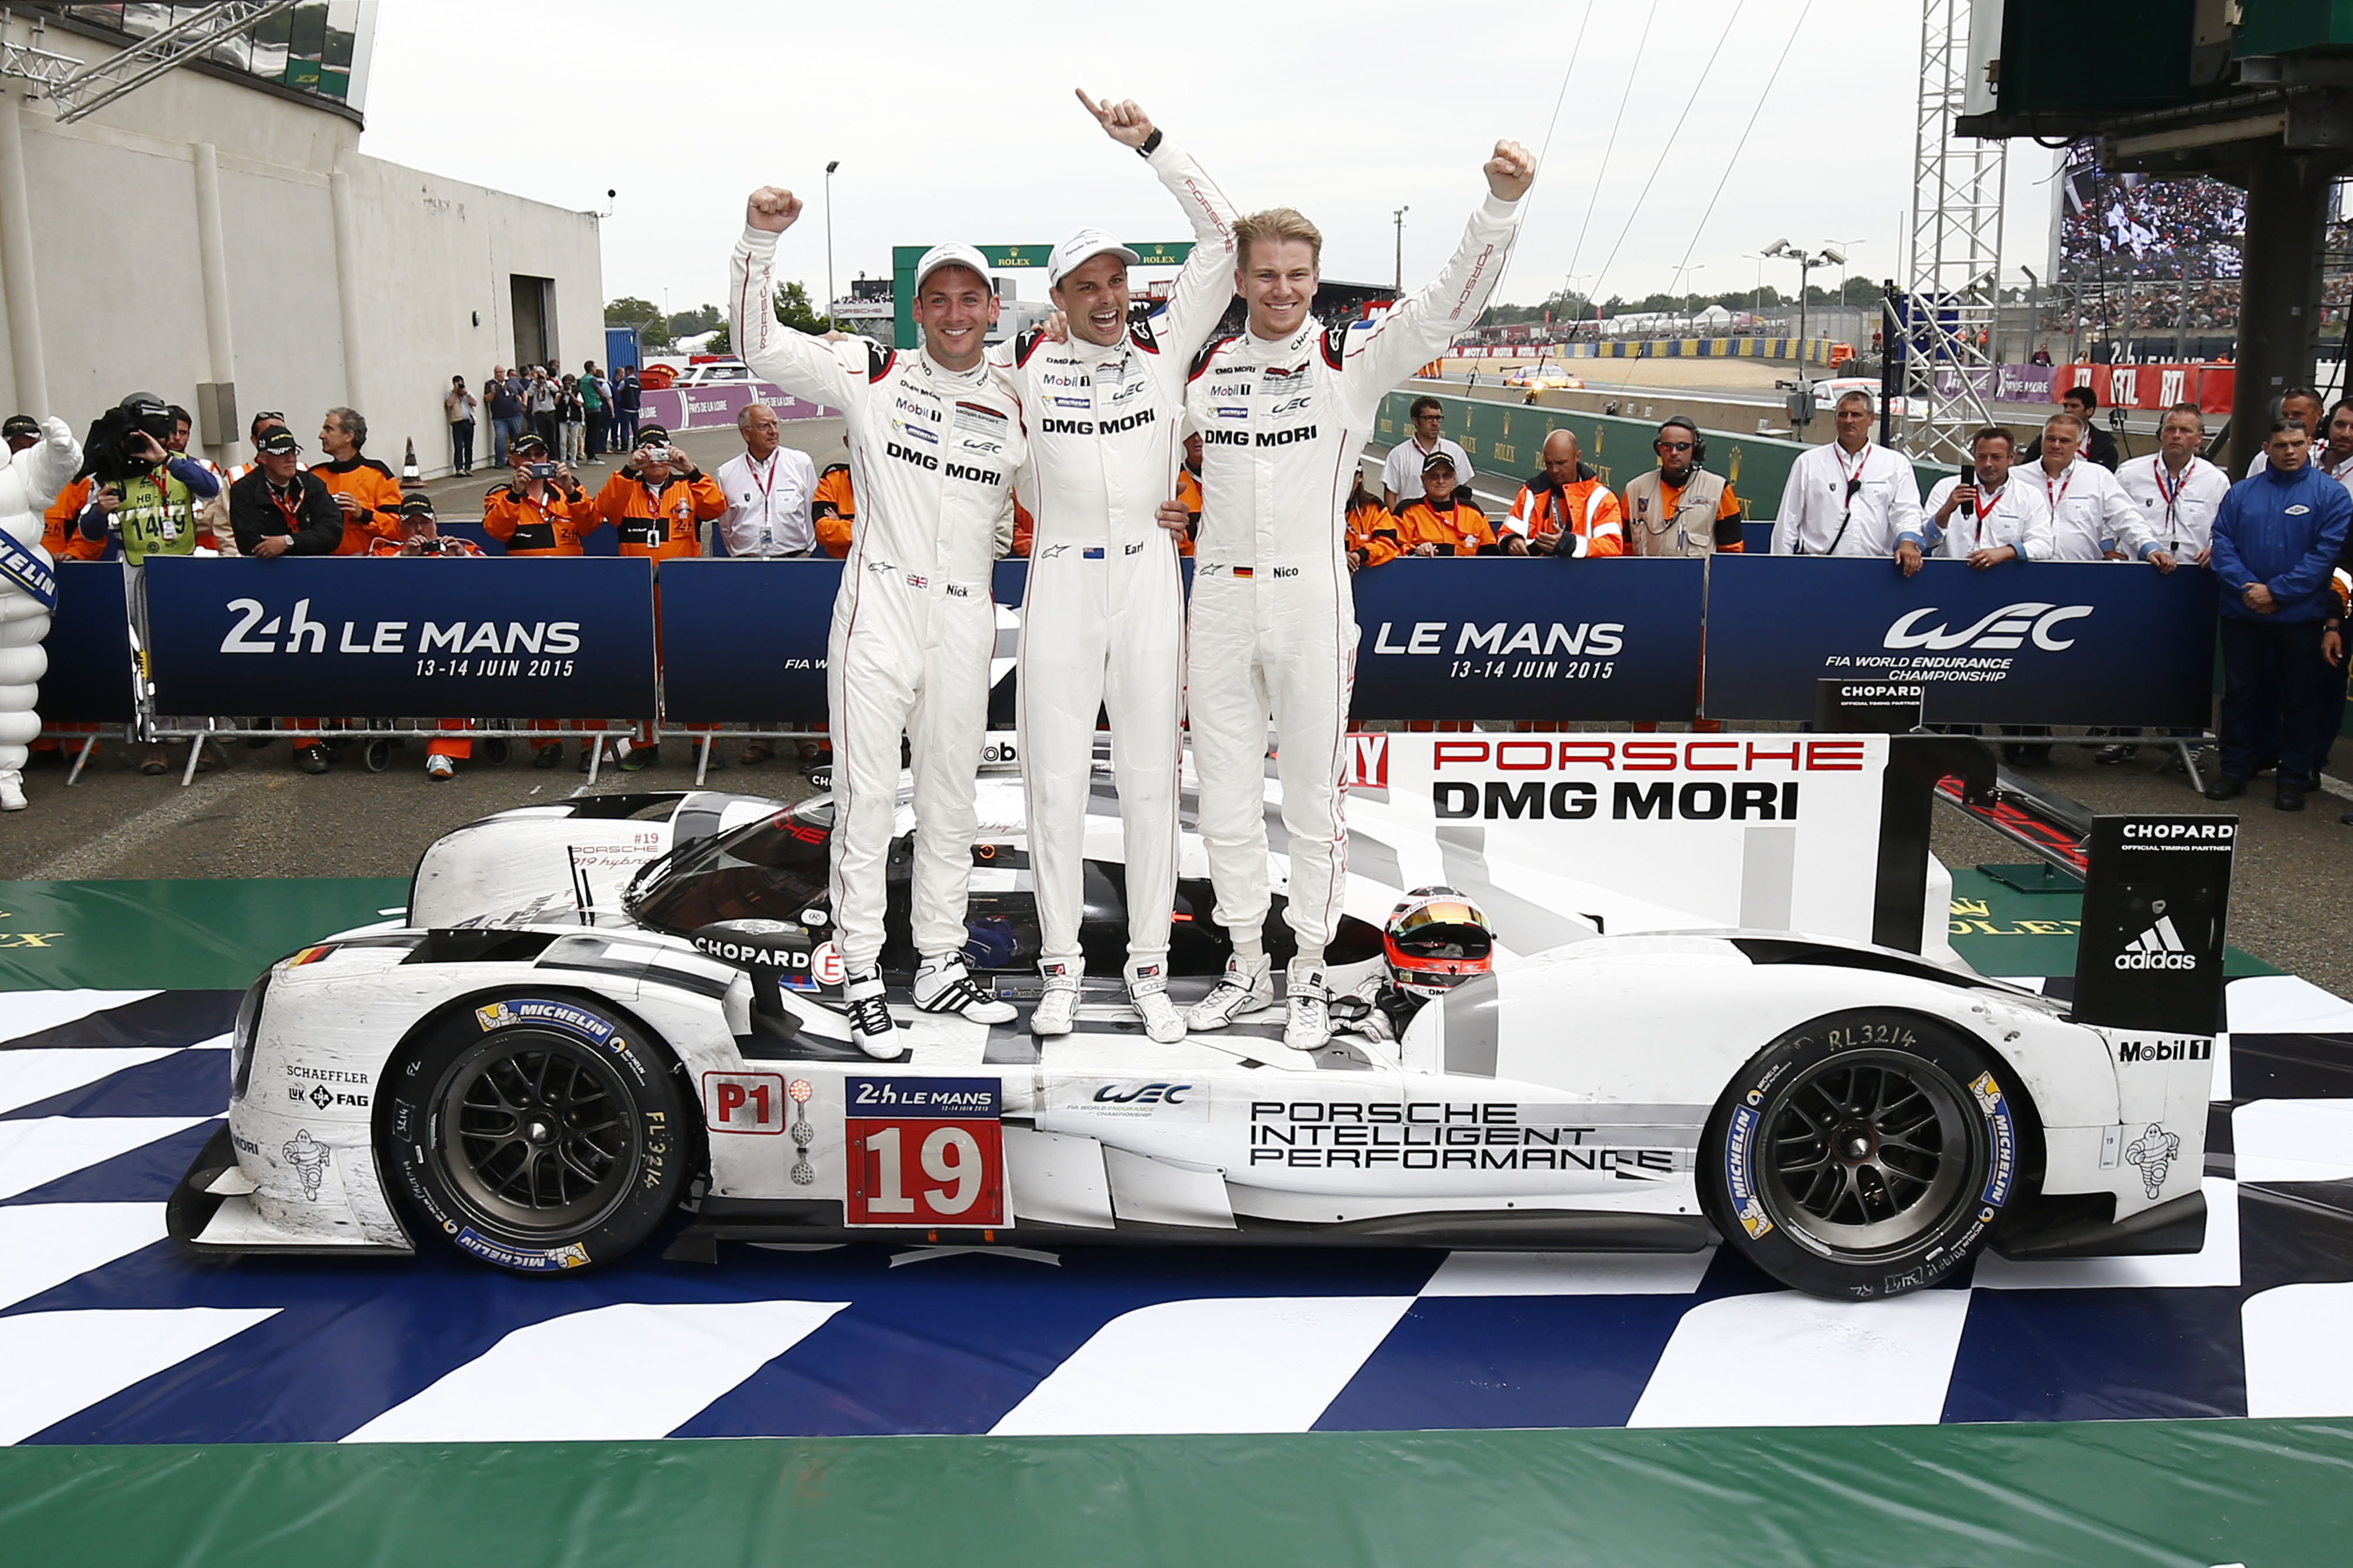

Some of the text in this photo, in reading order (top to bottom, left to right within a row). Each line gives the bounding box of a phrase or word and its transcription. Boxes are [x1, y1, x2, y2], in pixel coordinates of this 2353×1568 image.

[1185, 179, 1234, 254] PORSCHE
[1143, 255, 1175, 264] ROLEX
[1449, 242, 1494, 321] PORSCHE
[1043, 374, 1090, 387] Mobil 1
[1112, 381, 1145, 401] WEC
[1210, 384, 1251, 396] Mobil 1
[2110, 369, 2139, 405] RTL
[2160, 370, 2186, 407] RTL
[688, 402, 700, 414] PAYS
[701, 401, 708, 412] DE
[714, 400, 728, 411] LOIRE
[896, 398, 942, 422] Mobil 1
[1042, 408, 1156, 435] DMG MORI
[963, 439, 1002, 454] WEC
[1205, 425, 1317, 447] DMG MORI
[1494, 442, 1516, 463] ROLEX
[886, 442, 939, 471] DMG
[945, 463, 1001, 486] MORI
[137, 493, 152, 504] HB
[1124, 541, 1144, 556] Earl
[1273, 565, 1300, 579] Nico
[946, 584, 969, 597] Nick
[220, 597, 582, 654] 24h LE MANS
[1883, 602, 2095, 651] WEC
[1374, 622, 1625, 655] LE MANS
[415, 660, 575, 677] 13-14 JUIN 2015
[785, 659, 810, 669] FIA
[1450, 660, 1614, 679] 13-14 JUIN 2015
[1825, 656, 2013, 669] FIA WORLD ENDURANCE
[1888, 669, 2007, 682] CHAMPIONSHIP
[1841, 686, 1921, 697] CHOPARD
[1433, 740, 1866, 772] PORSCHE
[1433, 781, 1799, 820] DMG MORI
[634, 832, 659, 845] #19
[2123, 824, 2233, 839] CHOPARD
[695, 937, 810, 968] CHOPARD
[2114, 949, 2197, 971] adidas
[824, 955, 841, 976] E
[520, 1004, 609, 1037] MICHELIN
[623, 1049, 646, 1074] MICHELIN
[2118, 1039, 2213, 1063] Mobil 1
[287, 1065, 369, 1084] SCHAEFFLER
[1757, 1064, 1780, 1090] MICHELIN
[336, 1094, 369, 1106] FAG
[717, 1083, 769, 1123] P1
[855, 1082, 993, 1105] 24h LE MANS
[1093, 1082, 1193, 1105] WEC
[1250, 1102, 1518, 1124] PORSCHE
[1250, 1124, 1597, 1146] INTELLIGENT
[2106, 1137, 2114, 1145] 19
[1250, 1148, 1672, 1173] PERFORMANCE
[1729, 1111, 1752, 1201] MICHELIN
[1991, 1114, 2010, 1203] MICHELIN
[866, 1127, 983, 1215] 19
[461, 1235, 545, 1268] MICHELIN
